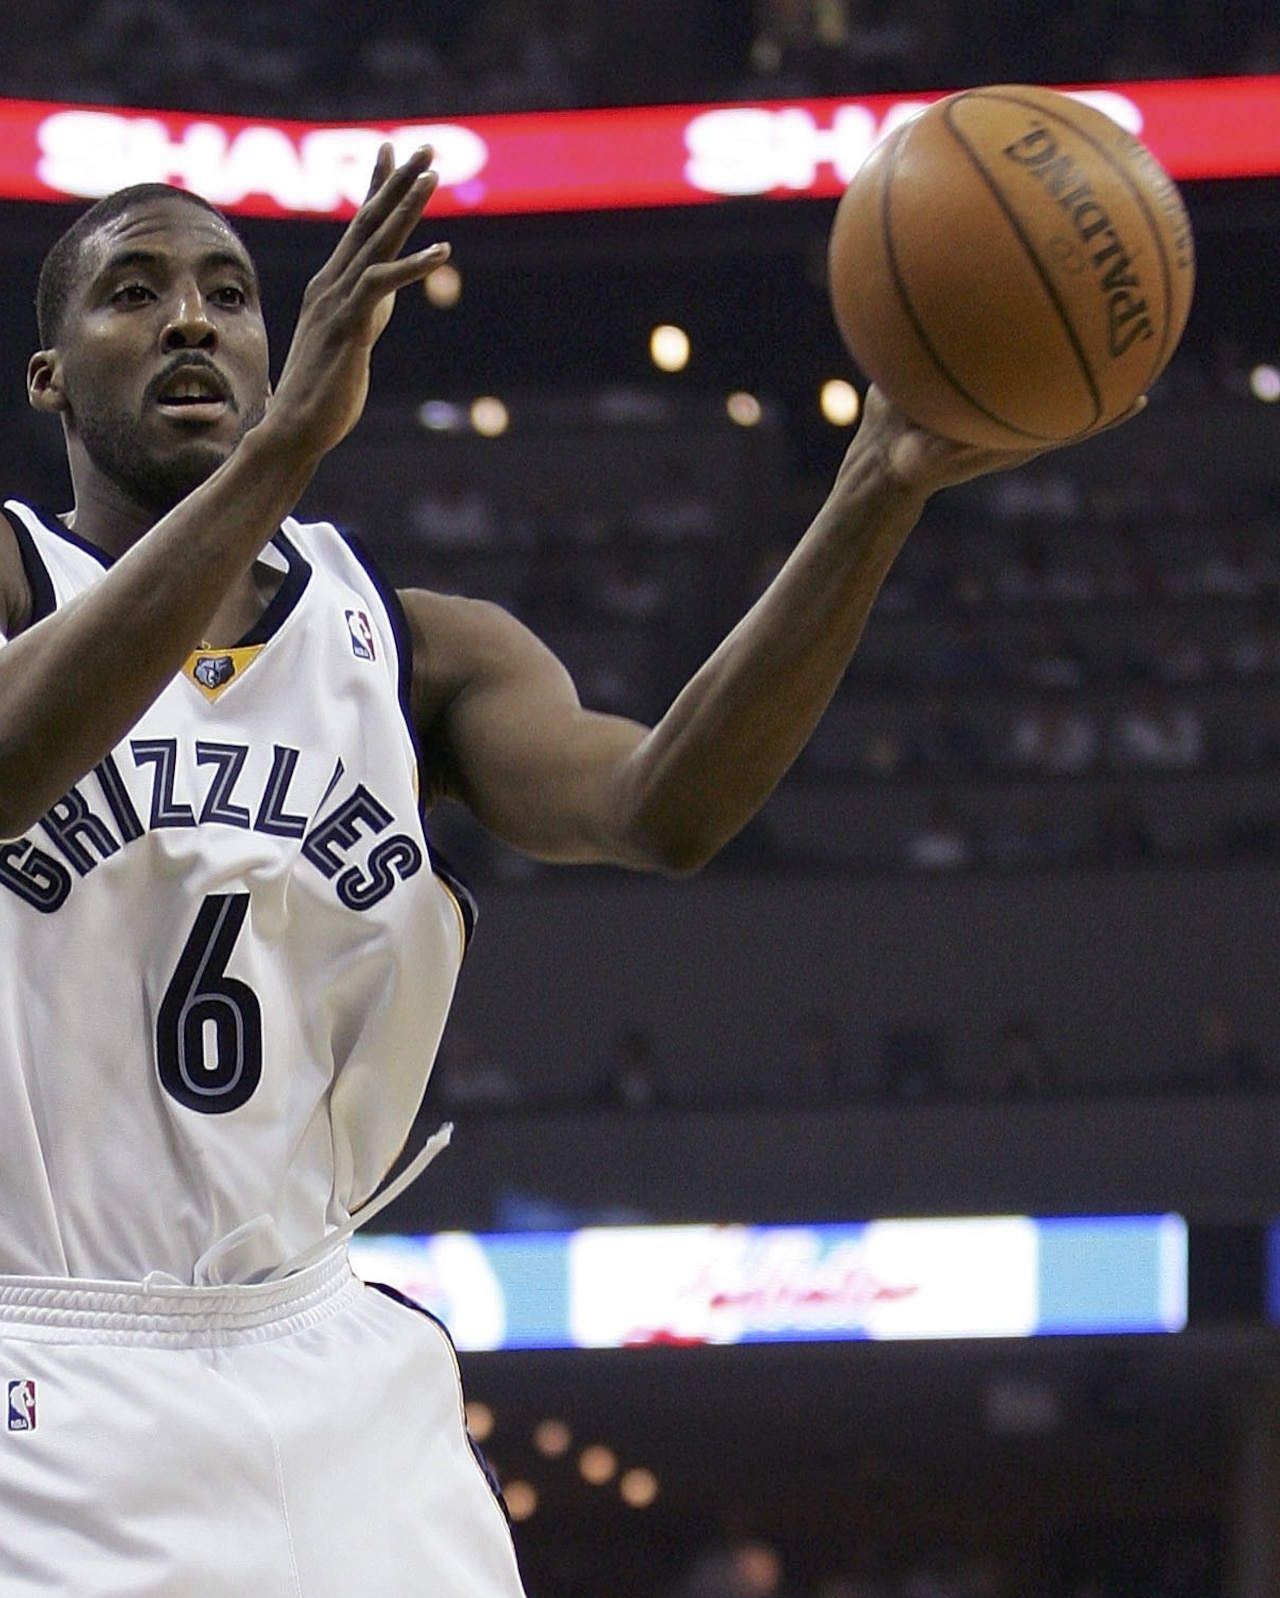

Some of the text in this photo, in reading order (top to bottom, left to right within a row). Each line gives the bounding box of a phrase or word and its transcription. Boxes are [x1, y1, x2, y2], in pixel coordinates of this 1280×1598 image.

[37, 110, 488, 212] SHARP
[1004, 126, 1154, 358] SPALDING
[156, 892, 263, 1115] 6
